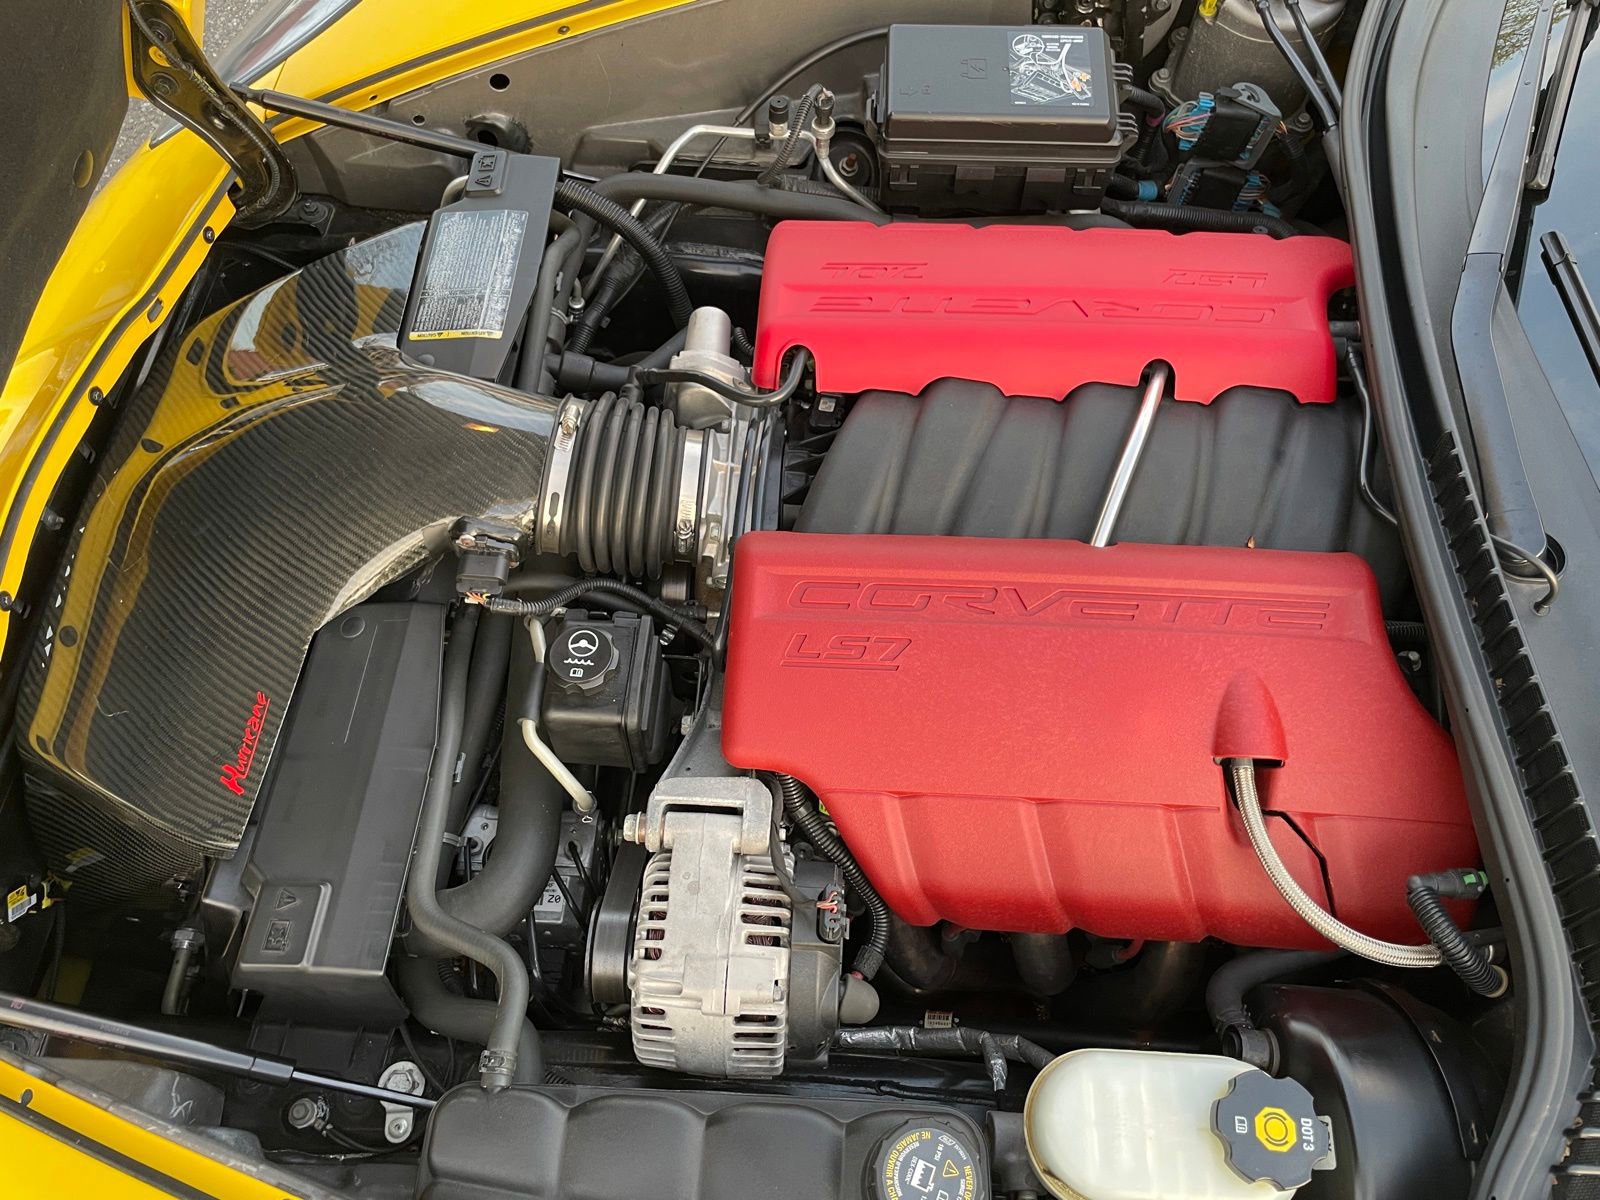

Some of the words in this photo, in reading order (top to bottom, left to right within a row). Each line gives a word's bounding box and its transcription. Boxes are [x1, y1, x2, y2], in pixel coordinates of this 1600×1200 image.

[1161, 270, 1267, 289] LS7
[809, 296, 1276, 323] CORVETTE
[787, 580, 1330, 630] CORVETTE
[784, 632, 912, 664] LS7
[220, 690, 269, 795] Hurricane
[895, 1132, 920, 1152] JAMAIS
[921, 1131, 931, 1140] NE
[1301, 1117, 1314, 1142] DOT
[1303, 1142, 1315, 1152] 3
[886, 1150, 900, 1178] OUVRIR
[963, 1165, 974, 1191] NEVER
